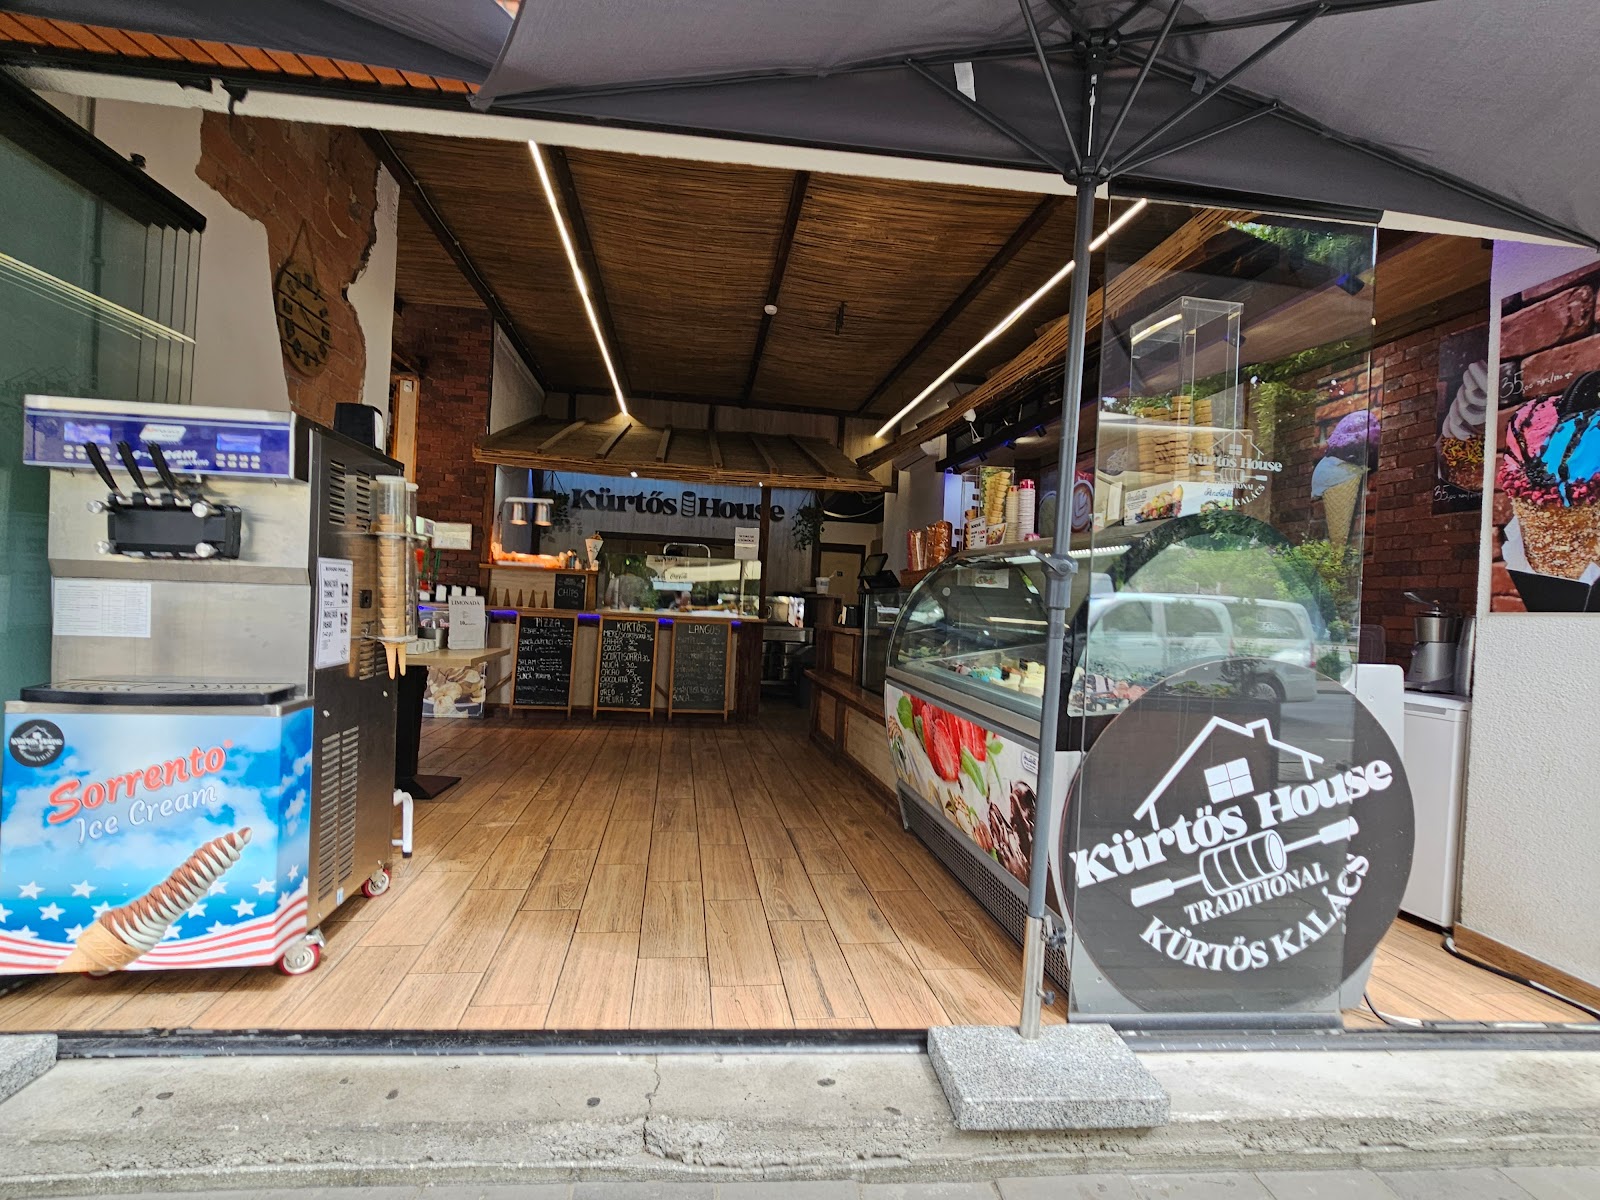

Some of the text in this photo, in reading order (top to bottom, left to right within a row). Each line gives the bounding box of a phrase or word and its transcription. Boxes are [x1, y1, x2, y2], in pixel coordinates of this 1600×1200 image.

[1188, 453, 1283, 472] Kürtös House
[571, 487, 677, 516] Kürtős
[534, 616, 561, 628] PIZZA
[47, 746, 227, 824] Sorrento
[76, 785, 217, 844] Ice Cream
[1069, 760, 1393, 889] Kürtös House
[1140, 853, 1370, 971] KÜRTÖS KALÁCS
[1184, 862, 1330, 925] TRADITIONAL
